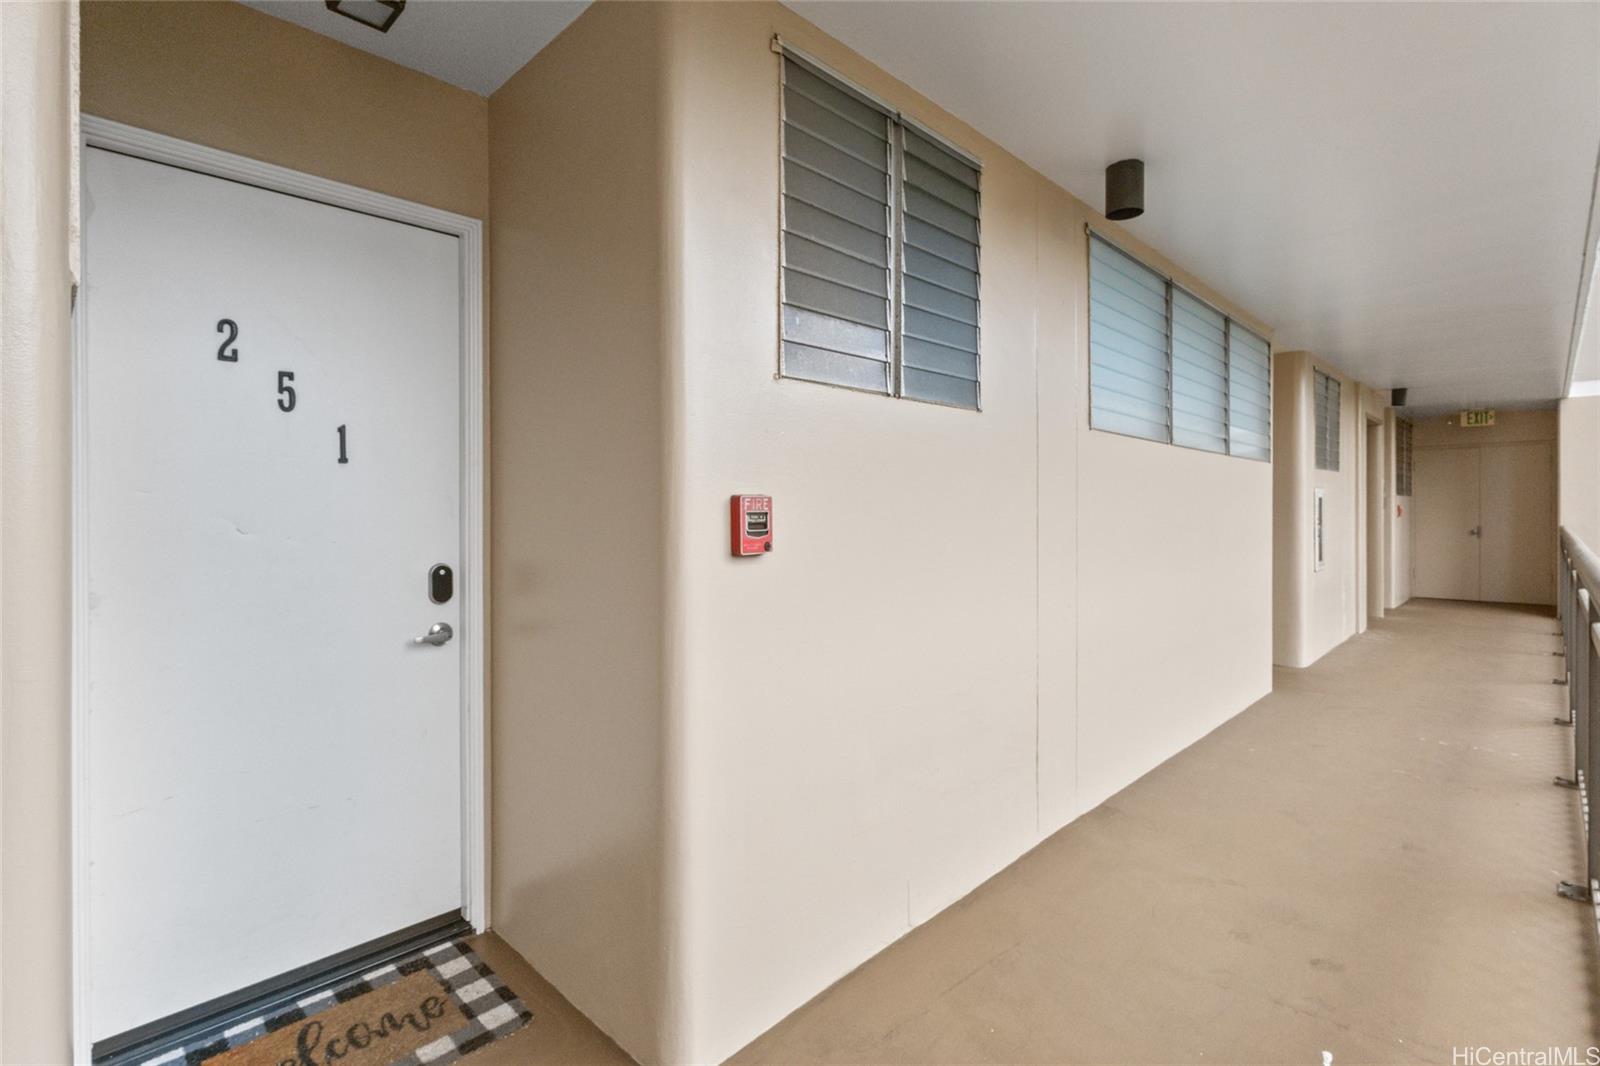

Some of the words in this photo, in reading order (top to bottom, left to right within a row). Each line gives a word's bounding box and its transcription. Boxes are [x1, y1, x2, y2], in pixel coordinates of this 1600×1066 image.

[1466, 410, 1490, 425] EXIT
[744, 498, 769, 511] FIRE
[275, 996, 447, 1066] lcome
